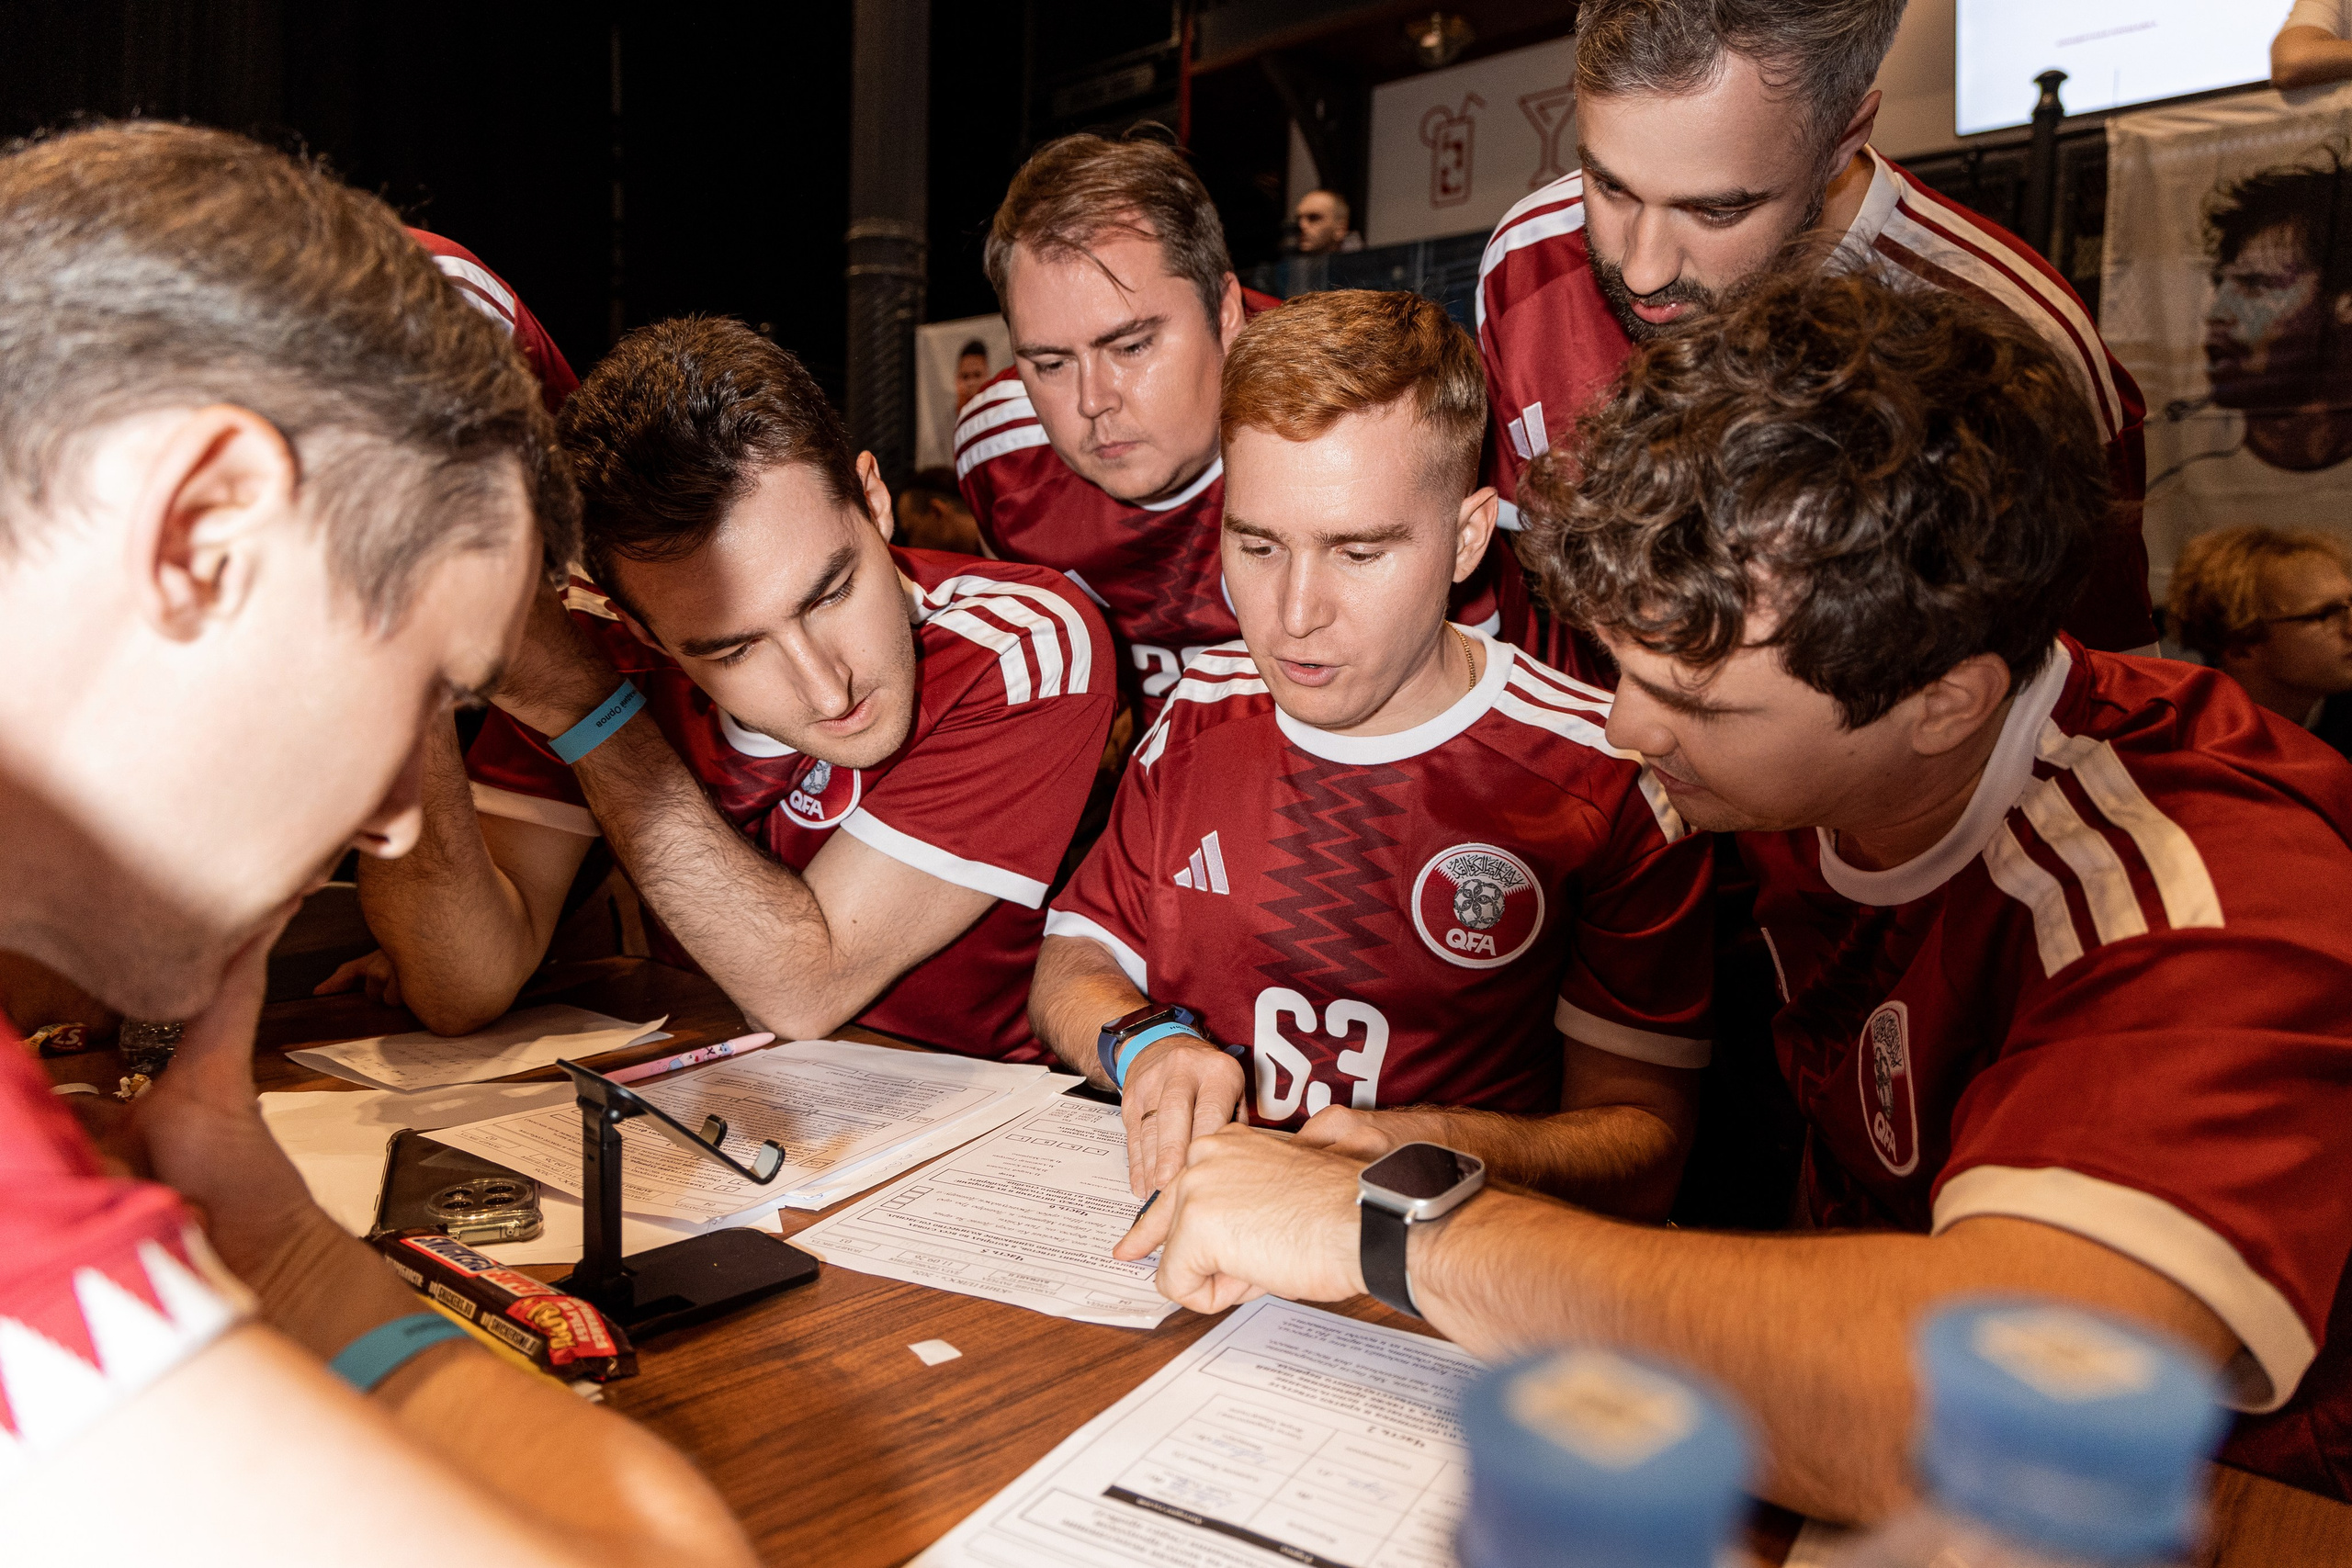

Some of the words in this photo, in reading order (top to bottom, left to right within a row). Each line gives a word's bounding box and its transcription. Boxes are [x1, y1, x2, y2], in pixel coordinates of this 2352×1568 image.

[1131, 644, 1209, 697] 2
[595, 705, 623, 728] Орлов
[788, 789, 826, 821] QFA
[1445, 928, 1497, 956] QFA
[1873, 1111, 1898, 1163] QFA
[540, 1156, 580, 1171] 11.09.26
[1054, 1206, 1091, 1216] Часть
[910, 1254, 956, 1266] 11.09.26
[988, 1250, 1026, 1260] Часть
[1377, 1427, 1427, 1448] Часть
